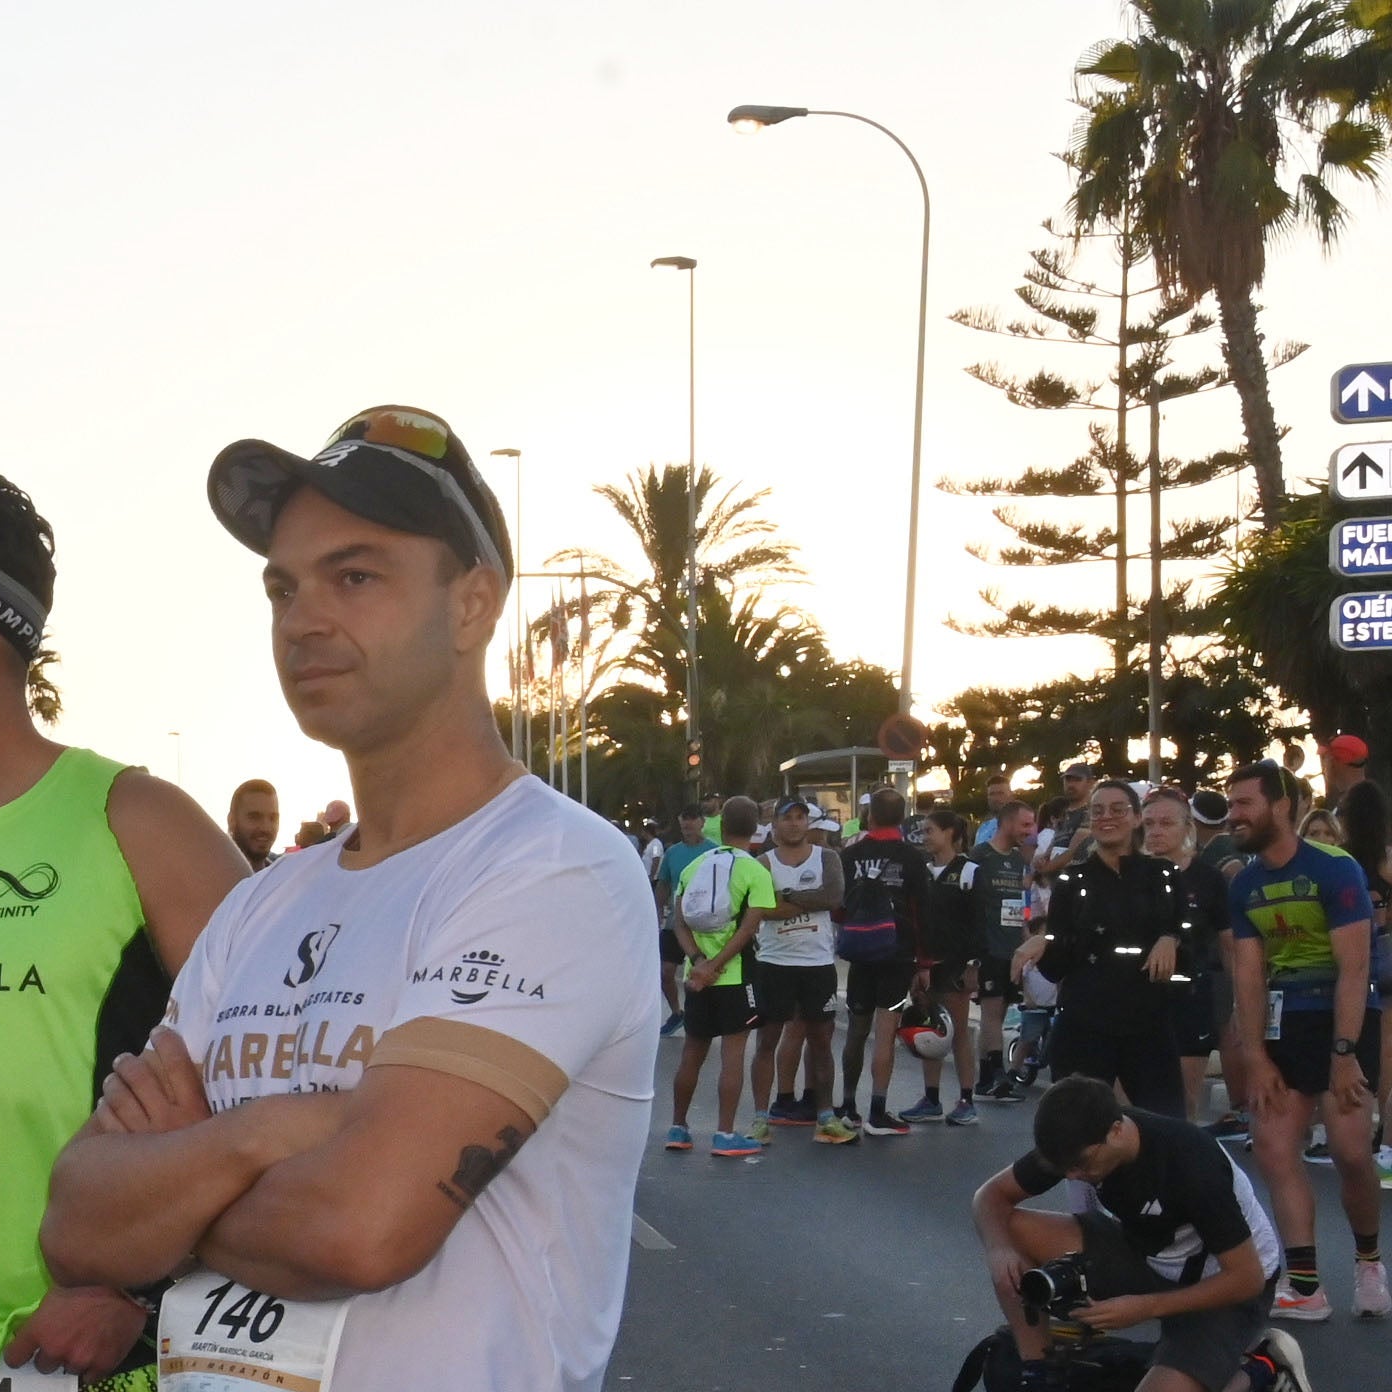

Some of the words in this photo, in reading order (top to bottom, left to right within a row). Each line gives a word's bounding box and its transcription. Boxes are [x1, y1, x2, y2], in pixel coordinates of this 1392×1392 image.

[1342, 523, 1392, 545] FUE
[412, 965, 545, 1000] MARBELLA
[194, 1280, 285, 1343] 146
